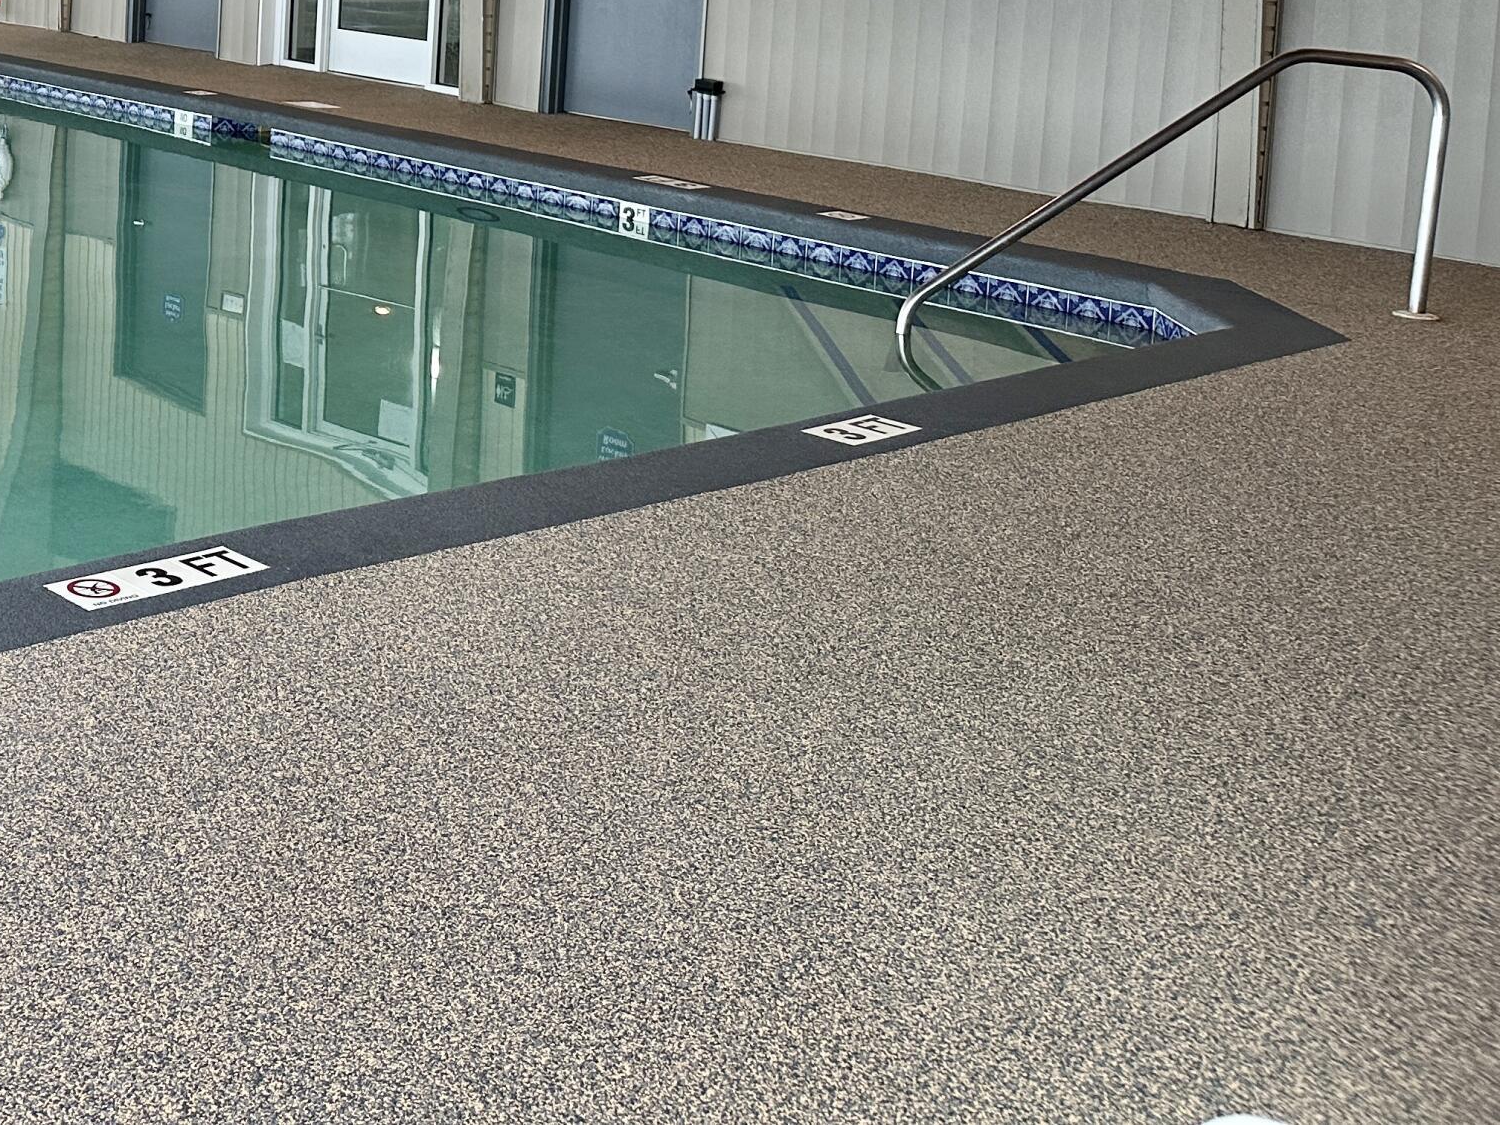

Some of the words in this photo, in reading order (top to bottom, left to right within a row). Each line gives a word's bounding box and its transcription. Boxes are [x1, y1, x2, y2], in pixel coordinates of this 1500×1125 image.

[823, 427, 867, 440] 3
[848, 417, 908, 435] FT
[135, 567, 184, 587] 3
[178, 549, 250, 577] FT
